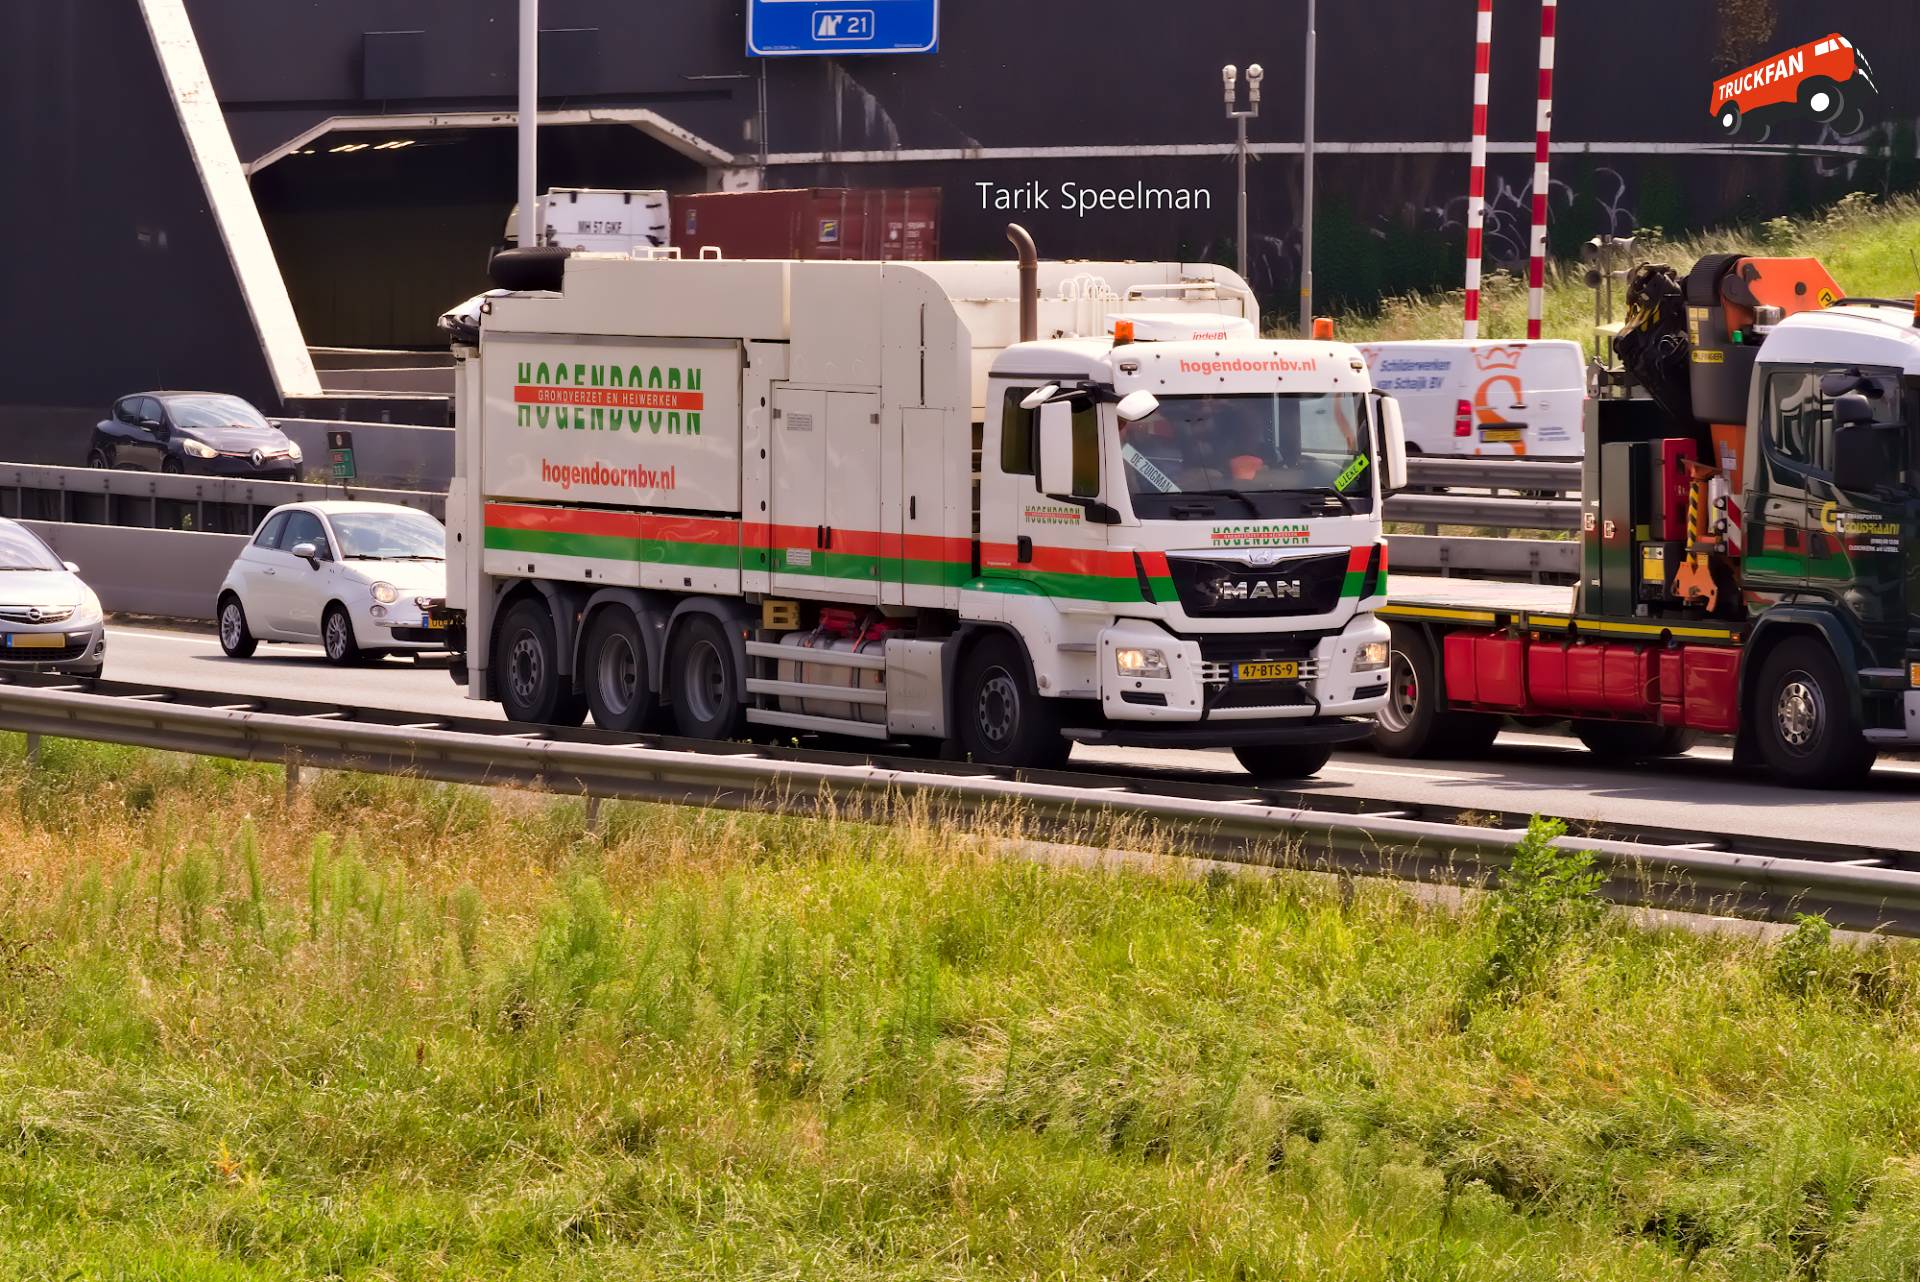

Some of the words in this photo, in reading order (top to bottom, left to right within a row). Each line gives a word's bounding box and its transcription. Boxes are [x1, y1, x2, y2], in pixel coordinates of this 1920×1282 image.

[847, 16, 867, 34] 21
[1180, 358, 1316, 375] hogendoornbv.nl
[518, 362, 701, 435] HOGENDOORN
[538, 389, 603, 404] GRONDVERZET
[606, 392, 618, 404] EN
[622, 393, 677, 407] HEIWERKEN
[542, 458, 675, 490] hogendoornbv.nl
[1213, 524, 1309, 546] HOGENDOORN
[1223, 580, 1300, 600] MAN
[1242, 663, 1293, 677] 47-BTS-9
